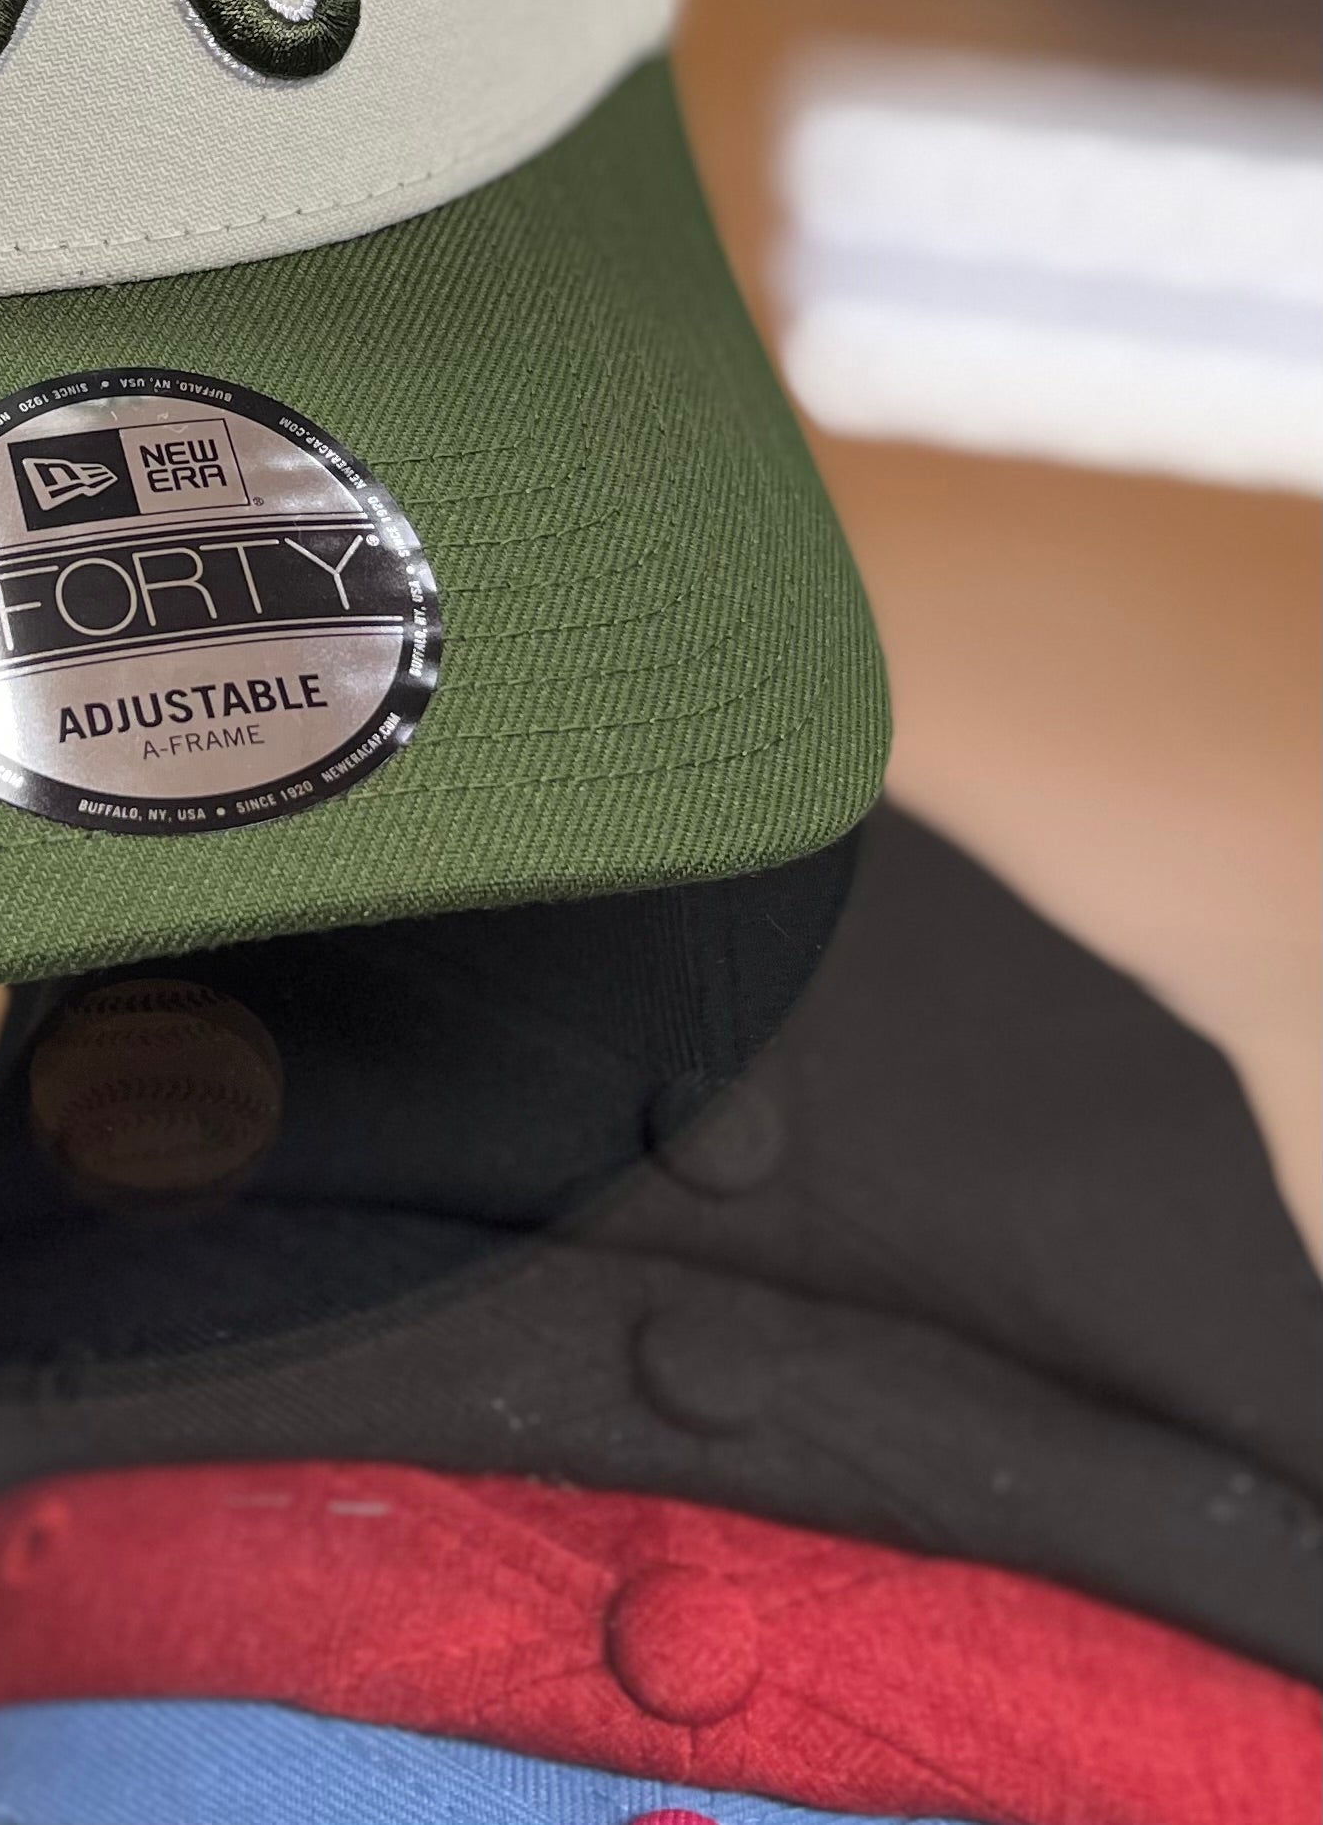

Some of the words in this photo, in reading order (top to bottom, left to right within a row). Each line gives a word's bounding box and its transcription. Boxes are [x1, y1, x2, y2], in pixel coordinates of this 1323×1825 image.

[51, 381, 89, 401] SINCE
[119, 378, 146, 389] USA
[17, 392, 50, 414] 1920
[139, 438, 219, 469] NEW
[278, 416, 368, 490] NEWERACAP.COM
[147, 463, 228, 493] ERA
[59, 673, 328, 744] ADJUSTABLE
[143, 724, 266, 760] A-FRAME
[78, 798, 143, 822] BUFFALO,
[177, 807, 207, 821] USA
[235, 793, 278, 815] SINCE
[279, 780, 314, 804] 1920
[320, 710, 402, 784] NEWERACAP.COM
